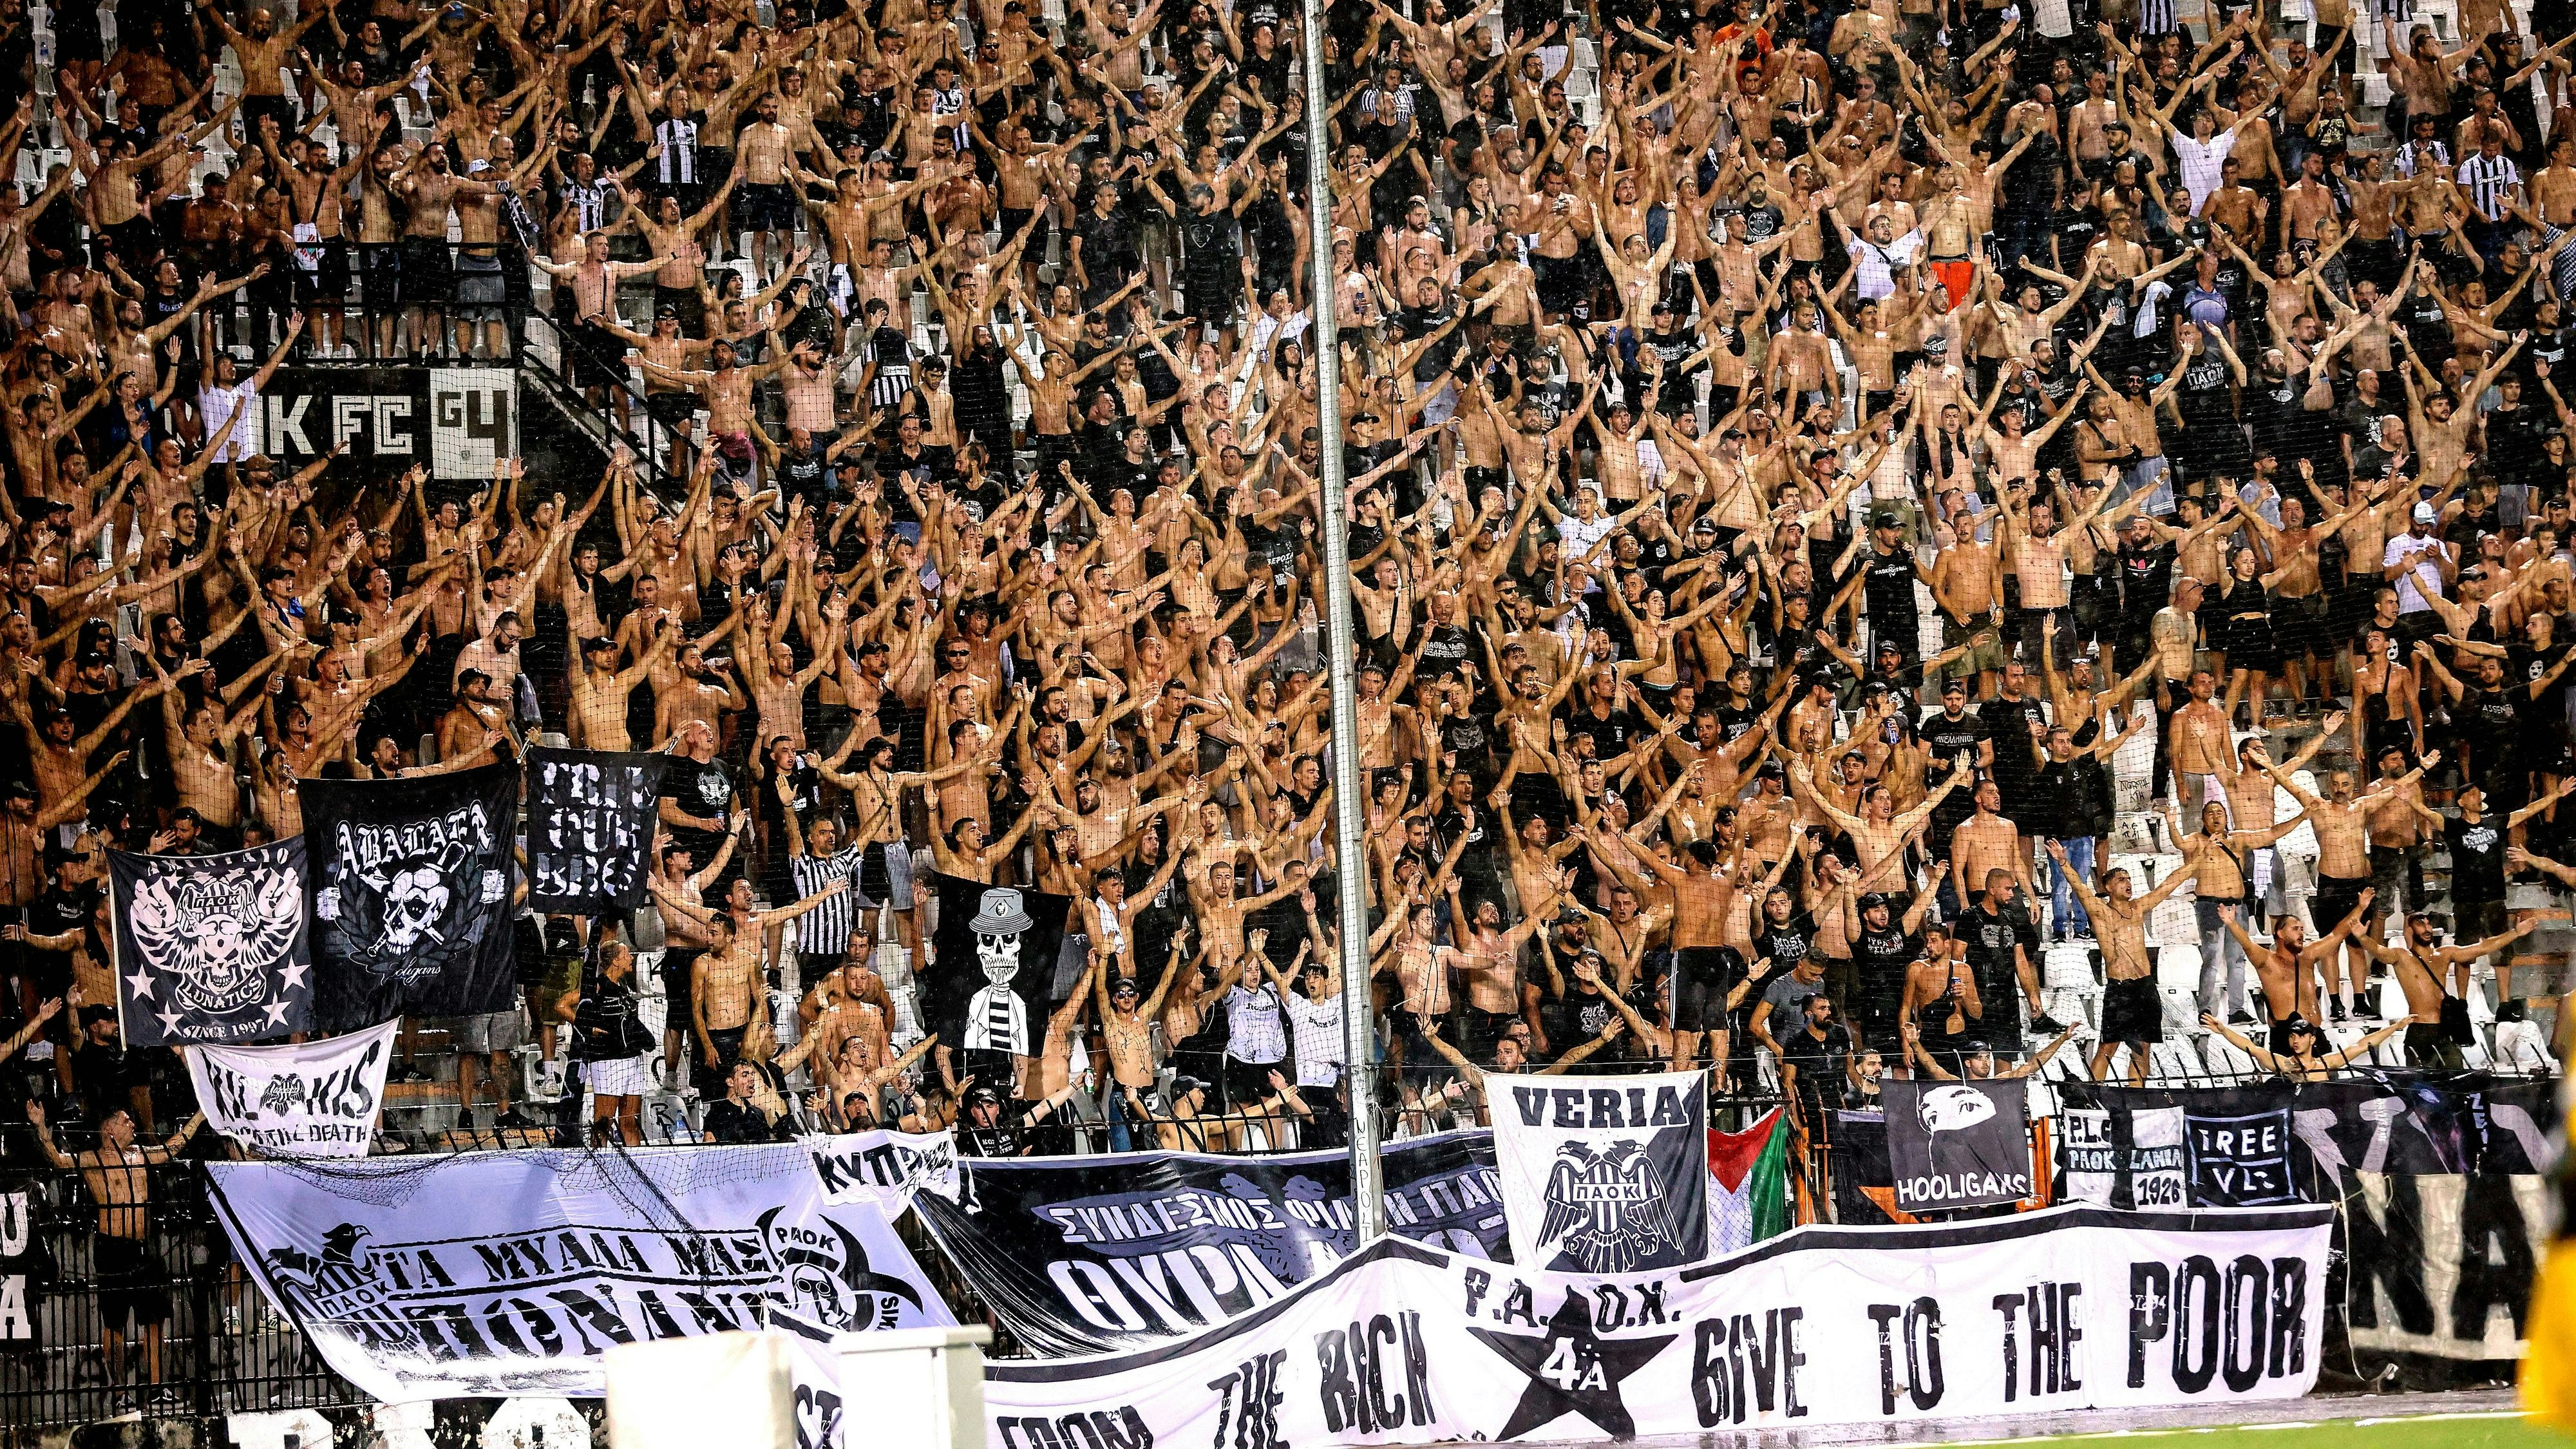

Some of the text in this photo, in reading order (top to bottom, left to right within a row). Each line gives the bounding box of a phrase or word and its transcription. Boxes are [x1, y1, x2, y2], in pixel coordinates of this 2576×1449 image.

[332, 395, 413, 455] FC
[439, 390, 509, 459] G4
[196, 895, 240, 907] ΠΑΟΚ
[182, 976, 261, 1009] LUNATICS
[182, 1019, 268, 1039] SINCE 1997
[1513, 1086, 1690, 1128] VERIA
[309, 1123, 368, 1143] DEATH
[2069, 1149, 2117, 1170] PAOK
[1576, 1186, 1638, 1200] ΠΑΟΚ
[1897, 1173, 2029, 1204] HOOLIGANS
[2137, 1176, 2181, 1206] 1926
[1048, 1192, 1287, 1243] ΣΥΝΔΕΣΜΟΣ
[1419, 1170, 1504, 1219] ΠΑΟ
[774, 1226, 837, 1253] PAOK
[1206, 1348, 1291, 1449] THE
[1313, 1311, 1436, 1434] RICH
[1691, 1306, 1808, 1428] GIVE
[1868, 1295, 1945, 1415] TO
[1992, 1282, 2082, 1403] THE
[2126, 1254, 2307, 1394] POOR
